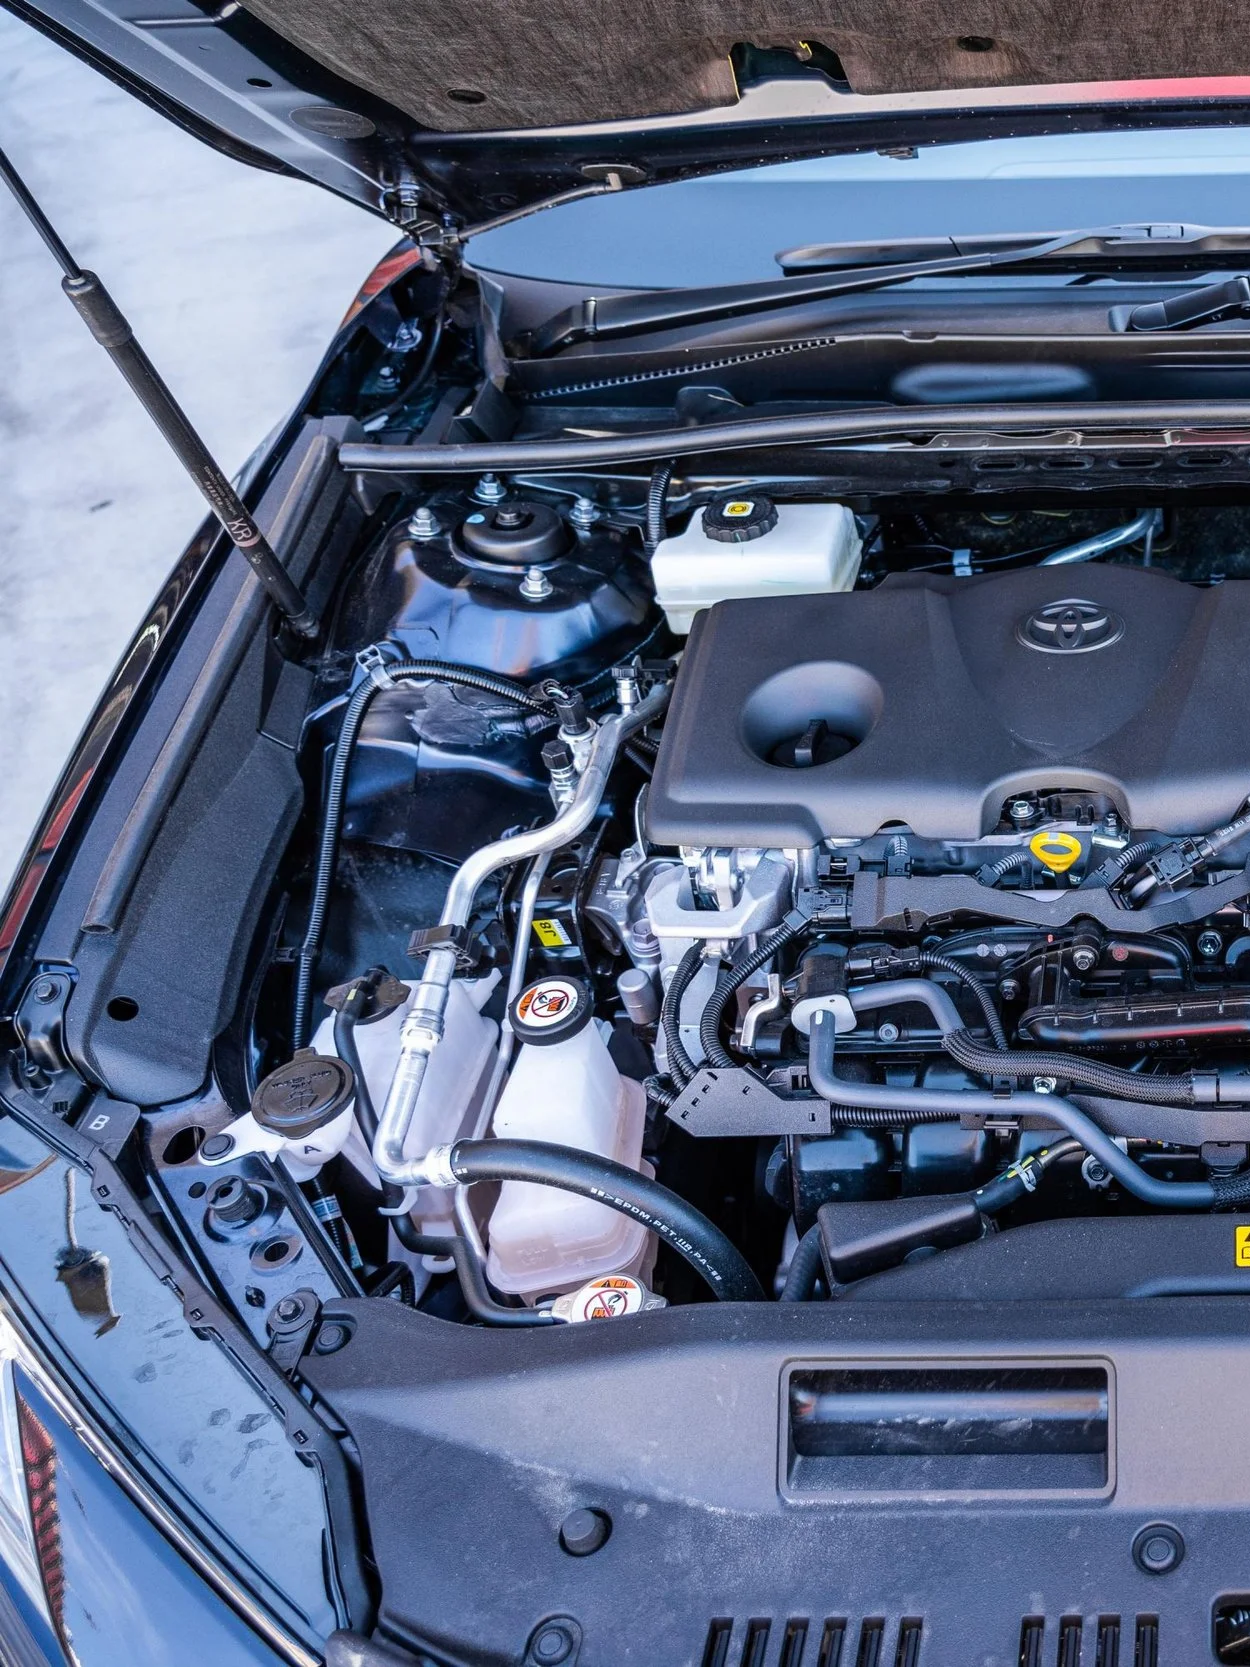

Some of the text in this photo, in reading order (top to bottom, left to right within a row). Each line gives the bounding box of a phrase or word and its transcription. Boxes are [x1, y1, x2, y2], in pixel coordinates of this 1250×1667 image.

[227, 517, 252, 541] KR
[539, 921, 557, 937] J8
[88, 1114, 111, 1131] B
[304, 1145, 322, 1155] A
